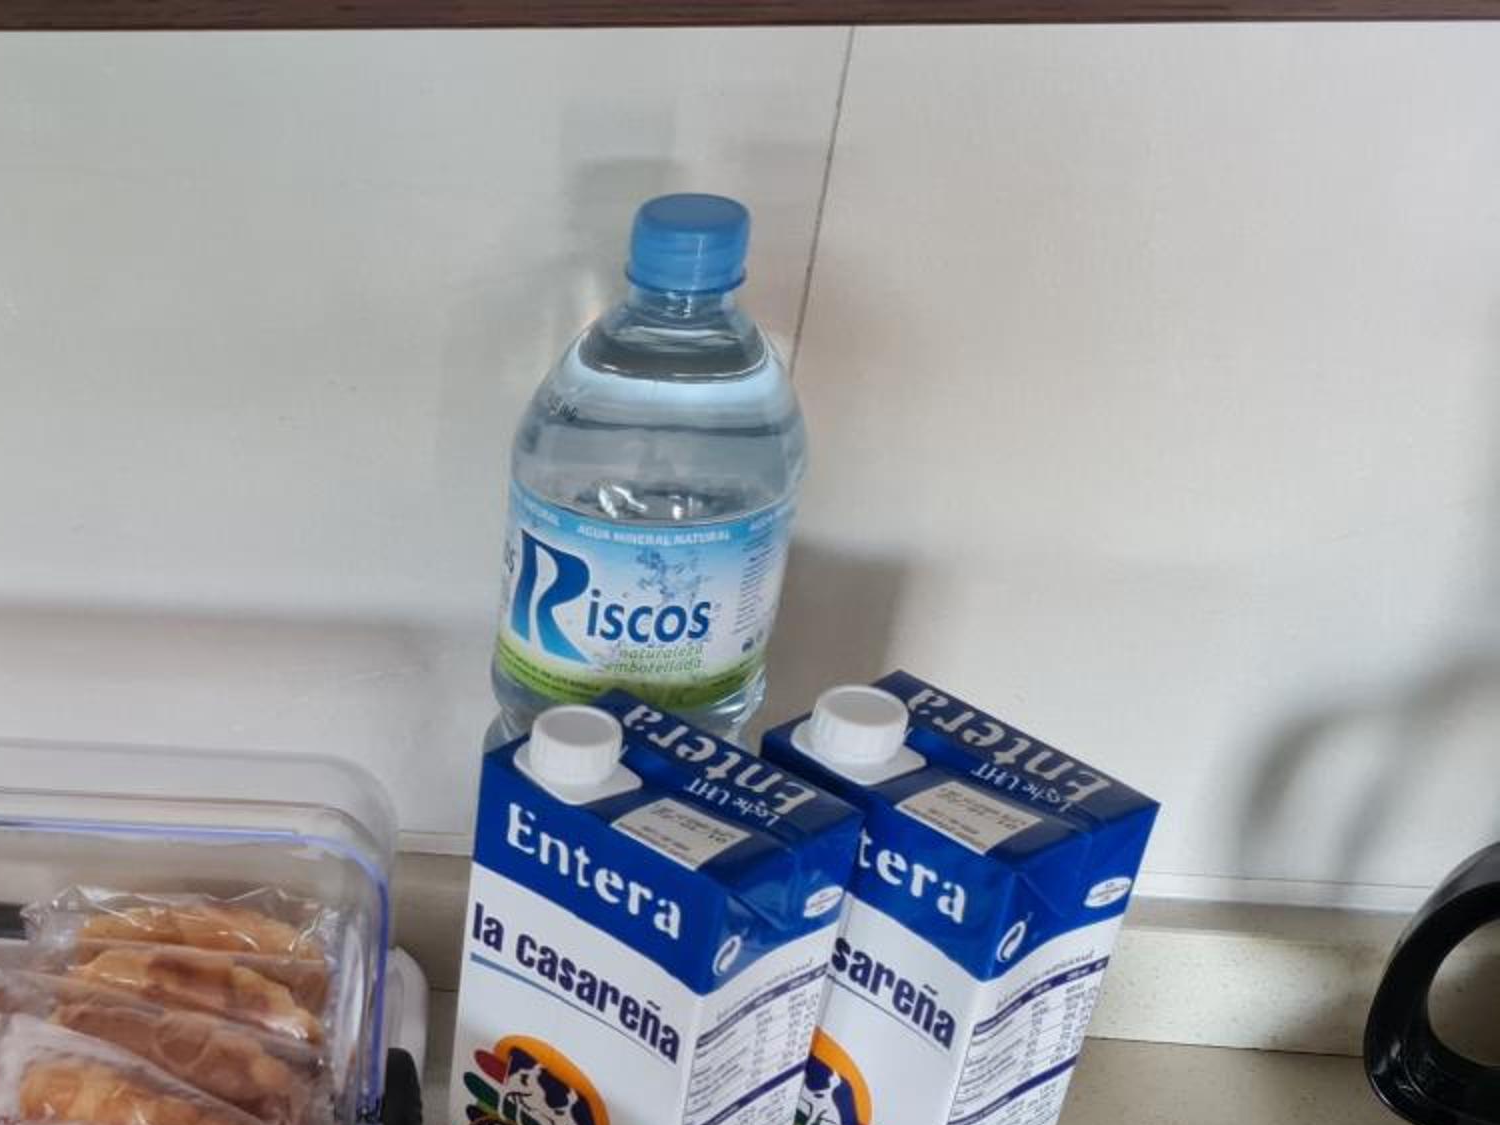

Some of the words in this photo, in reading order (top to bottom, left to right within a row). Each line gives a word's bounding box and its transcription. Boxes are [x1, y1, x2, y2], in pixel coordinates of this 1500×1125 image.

[510, 528, 713, 665] Riscos
[622, 703, 818, 816] Entera
[685, 778, 730, 806] UHT
[907, 688, 1112, 803] Entera
[971, 763, 1020, 791] UHT
[507, 802, 682, 940] Entera
[858, 827, 967, 924] tera
[471, 901, 505, 953] la
[515, 932, 681, 1064] casareña
[831, 937, 956, 1051] sareña
